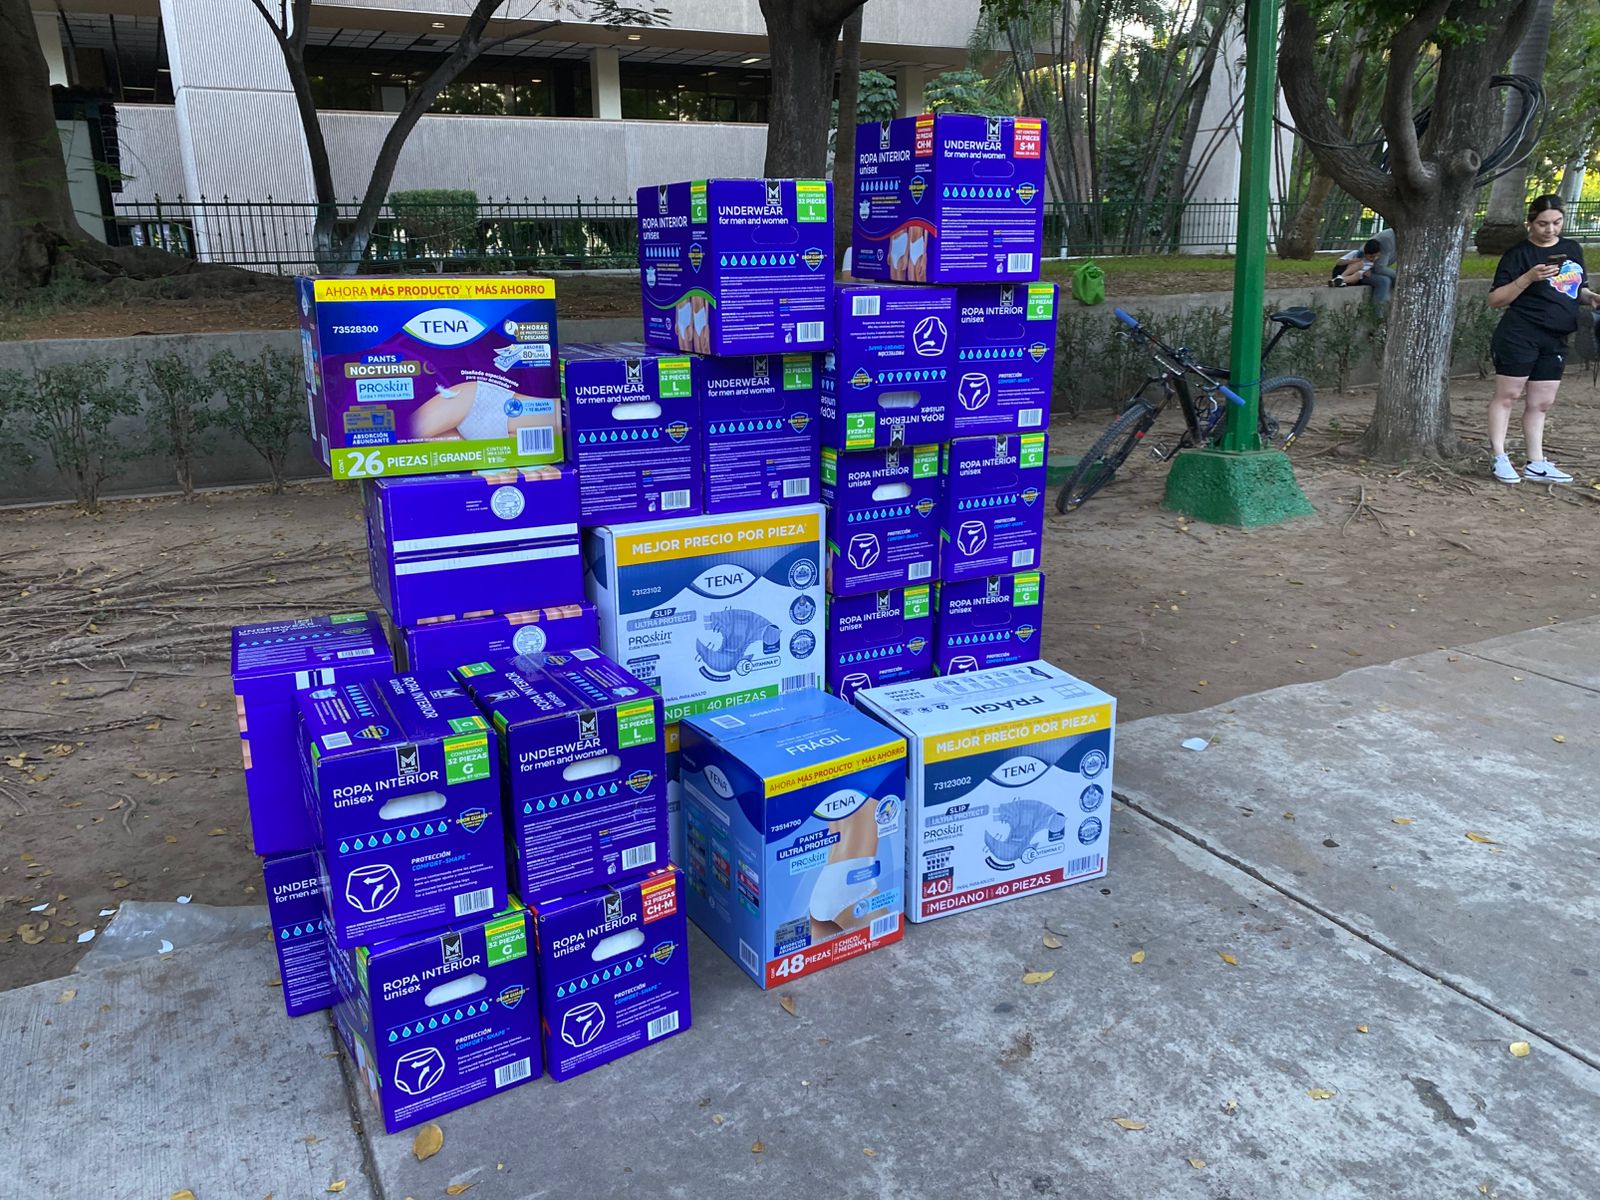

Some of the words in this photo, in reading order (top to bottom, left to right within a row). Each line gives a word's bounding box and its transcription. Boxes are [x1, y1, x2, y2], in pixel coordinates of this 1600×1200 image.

[944, 140, 1002, 151] UNDERWEAR
[1020, 142, 1035, 151] S-M
[860, 153, 878, 164] ROPA
[878, 150, 910, 162] INTERIOR
[860, 164, 878, 174] unisex
[718, 206, 783, 216] UNDERWEAR
[642, 218, 658, 229] ROPA
[659, 216, 688, 228] INTERIOR
[643, 231, 660, 240] unisex
[326, 287, 367, 296] AHORA
[370, 284, 394, 295] MÁS
[398, 286, 460, 296] PRODUCTO
[466, 286, 472, 294] Y
[475, 284, 497, 294] MÁS
[500, 285, 545, 294] AHORRO
[962, 307, 984, 316] ROPA
[986, 306, 1023, 315] INTERIOR
[332, 326, 378, 334] 73528300
[420, 320, 468, 333] TENA
[350, 364, 416, 375] NOCTURNO
[673, 381, 679, 391] L
[707, 377, 770, 388] UNDERWEAR
[575, 384, 644, 395] UNDERWEAR
[576, 396, 587, 405] for
[588, 396, 605, 404] men
[621, 394, 650, 402] women
[921, 405, 945, 413] unisex
[880, 415, 920, 426] INTERIOR
[922, 413, 944, 422] ROPA
[347, 450, 384, 476] 26
[387, 455, 428, 467] PIEZAS
[439, 451, 482, 462] GRANDE
[960, 460, 981, 469] ROPA
[982, 457, 1016, 467] INTERIOR
[848, 472, 870, 481] ROPA
[872, 466, 909, 478] INTERIOR
[960, 468, 981, 476] unisex
[848, 480, 871, 488] unisex
[632, 539, 680, 556] MEJOR
[684, 533, 734, 548] PRECIO
[738, 529, 764, 542] POR
[768, 524, 805, 539] PIEZA
[704, 574, 742, 588] TENA
[632, 586, 662, 596] 73123102
[1023, 592, 1030, 601] G
[950, 599, 972, 608] ROPA
[973, 595, 1009, 605] INTERIOR
[913, 605, 920, 613] G
[949, 606, 972, 614] unisex
[635, 619, 657, 629] ULTRA
[658, 614, 691, 625] PROTECT
[840, 616, 862, 625] ROPA
[863, 609, 900, 622] INTERIOR
[840, 623, 863, 631] unisex
[664, 706, 691, 720] NDE
[707, 700, 722, 710] 40
[725, 690, 766, 707] PIEZAS
[961, 695, 1045, 714] FRÁGIL
[634, 728, 641, 738] L
[937, 736, 980, 754] MEJOR
[983, 726, 1030, 745] PRECIO
[1033, 722, 1058, 735] POR
[1061, 715, 1096, 729] PIEZA
[519, 738, 600, 763] UNDERWEAR
[786, 734, 850, 756] FRÁGIL
[451, 748, 483, 757] CONTENIDO
[459, 752, 487, 763] PIEZAS
[520, 764, 533, 772] for
[535, 759, 555, 770] men
[557, 755, 573, 766] and
[575, 748, 608, 762] women
[463, 763, 474, 774] G
[769, 778, 795, 792] AHORA
[797, 771, 812, 784] MÁS
[814, 762, 852, 779] PRODUCTO
[861, 753, 876, 765] MÁS
[877, 746, 905, 761] AHORRO
[1002, 763, 1036, 779] TENA
[333, 783, 372, 799] ROPA
[375, 771, 439, 791] INTERIOR
[708, 771, 728, 792] TENA
[934, 777, 971, 791] 73123002
[334, 794, 374, 808] unisex
[824, 795, 855, 812] TENA
[950, 805, 966, 814] SLIP
[954, 808, 984, 820] PROTECT
[771, 819, 801, 832] 73514700
[800, 831, 823, 844] PANTS
[779, 844, 804, 859] ULTRA
[805, 835, 839, 852] PROTECT
[411, 851, 451, 864] PROTECCIÓN
[412, 854, 466, 871] COMFORT-SHAPE
[273, 878, 317, 895] UNDER
[927, 880, 948, 895] 40
[930, 891, 985, 912] MEDIANO
[995, 885, 1009, 896] 40
[1012, 874, 1051, 892] PIEZAS
[289, 891, 309, 900] men
[653, 891, 675, 903] PIEZAS
[647, 899, 673, 914] CH-M
[491, 929, 520, 941] CONTENIDO
[553, 932, 584, 950] ROPA
[587, 913, 637, 938] INTERIOR
[499, 933, 525, 945] PIEZAS
[838, 938, 867, 953] MEDIANO
[502, 944, 512, 955] G
[554, 942, 586, 958] unisex
[775, 954, 804, 977] 48
[805, 950, 831, 965] PIEZAS
[383, 975, 419, 992] ROPA
[423, 955, 480, 980] INTERIOR
[384, 984, 421, 1000] unisex
[614, 982, 646, 999] PROTECCIÓN
[455, 1028, 492, 1044] PROTECCIÓN
[456, 1029, 505, 1051] COMFORT-SHAPE
